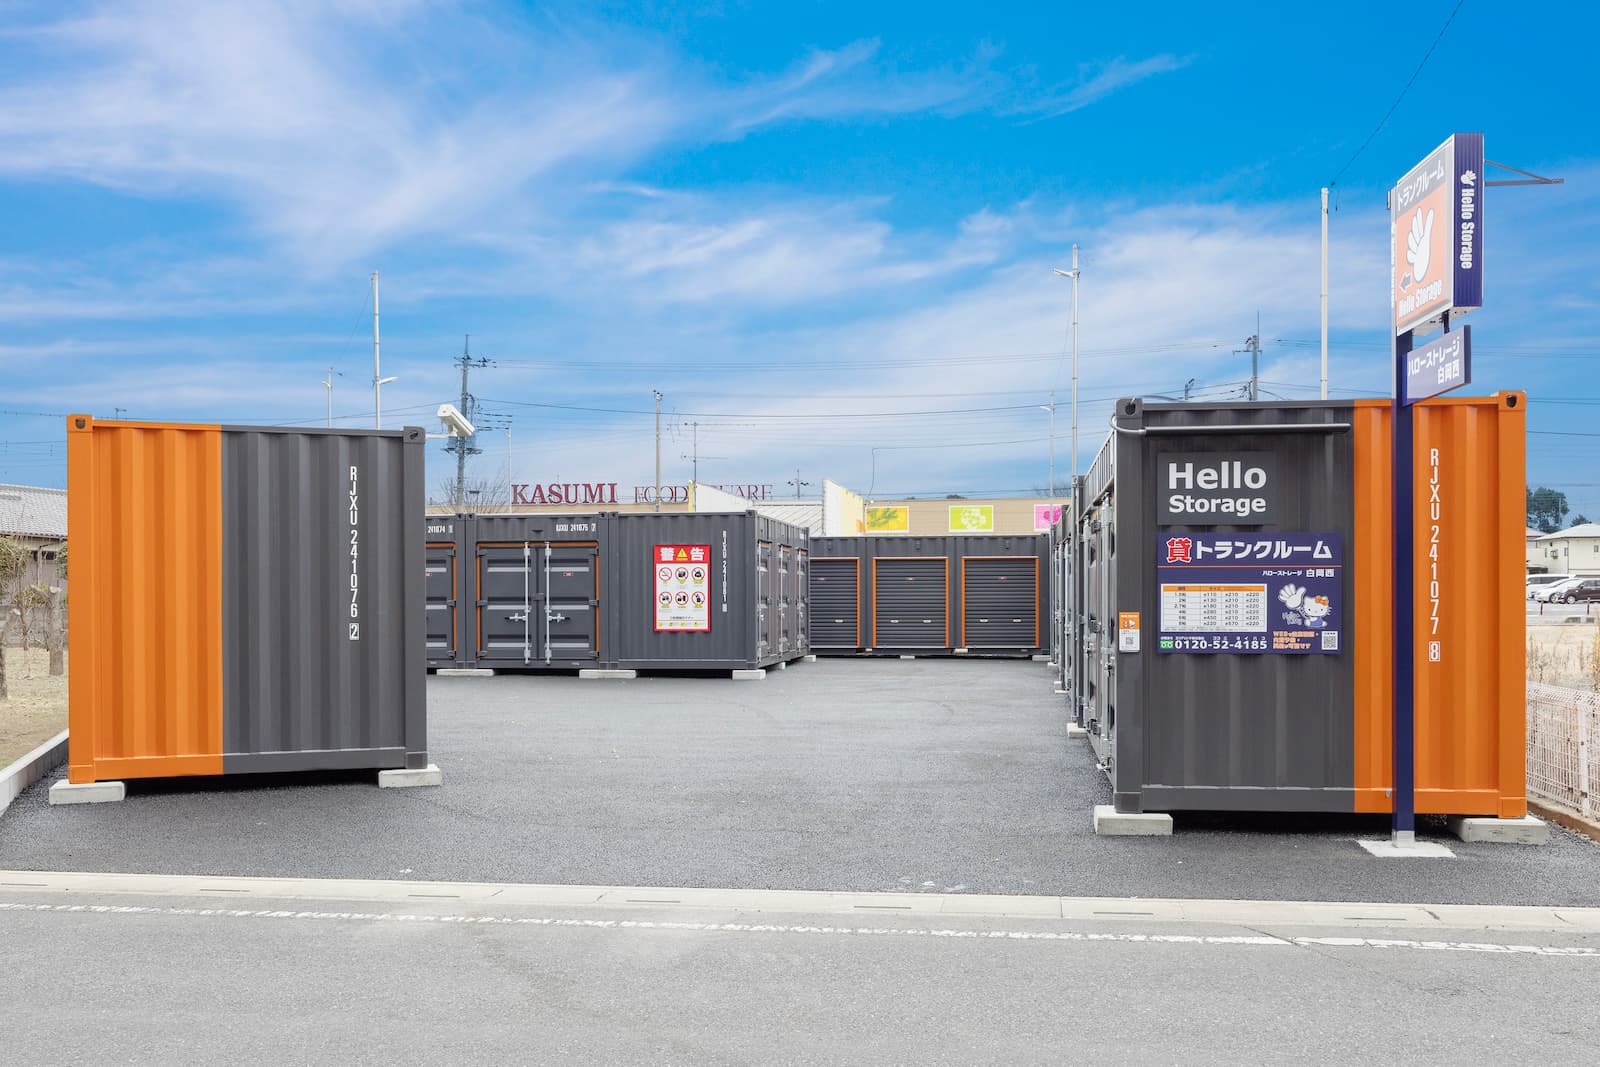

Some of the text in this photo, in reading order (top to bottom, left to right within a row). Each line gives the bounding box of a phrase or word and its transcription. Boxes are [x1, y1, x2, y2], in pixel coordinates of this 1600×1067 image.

[1398, 160, 1444, 211] トランクルーム
[1461, 188, 1475, 269] Hello Storage
[1415, 279, 1443, 311] Storage
[1408, 337, 1460, 376] ハローストレージ
[1437, 360, 1460, 385] 白岡西
[1168, 461, 1267, 490] Hello
[1429, 448, 1440, 521] RJXU
[511, 482, 618, 505] KASUMI
[633, 485, 689, 504] FOOD
[1168, 494, 1267, 517] Storage
[349, 466, 359, 641] RJXU 241076 2
[1262, 569, 1303, 577] ハローストレージ
[1429, 525, 1440, 635] 241077
[1174, 640, 1268, 650] 0120-52-4185
